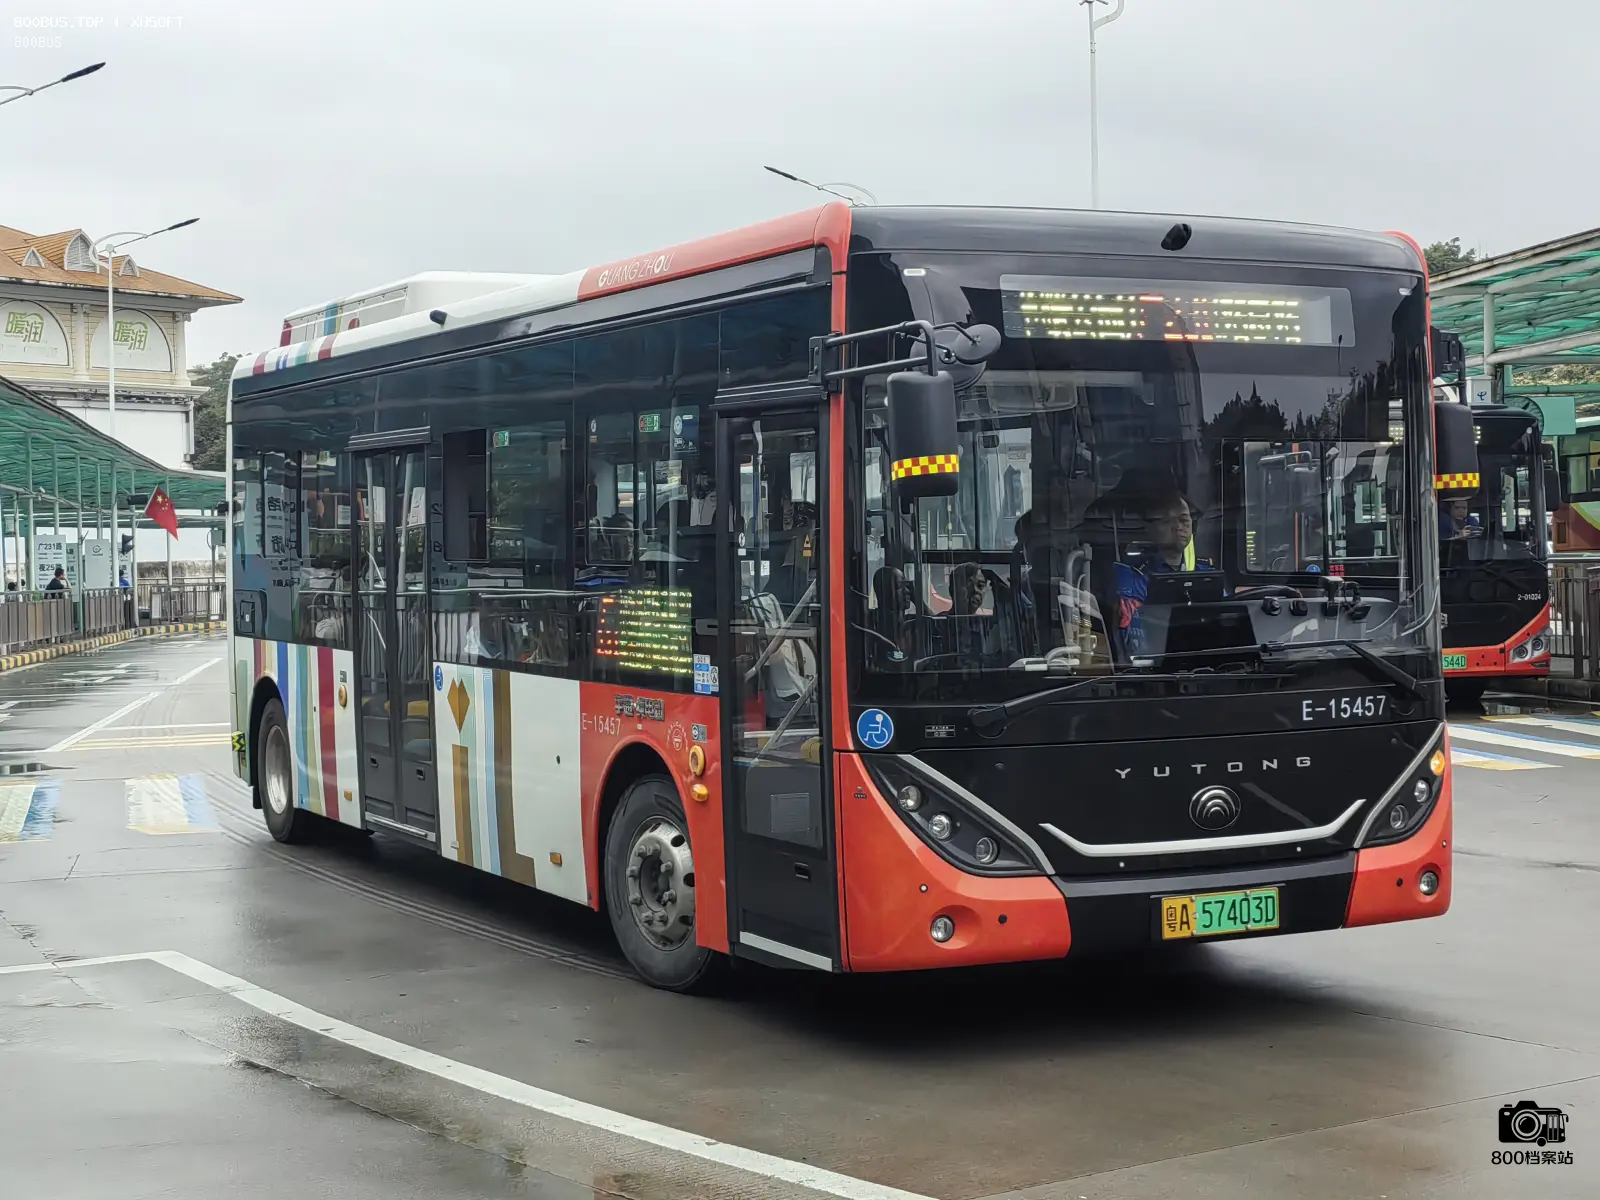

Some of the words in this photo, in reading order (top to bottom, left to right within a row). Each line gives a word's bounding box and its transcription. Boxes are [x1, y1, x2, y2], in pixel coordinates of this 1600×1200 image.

[598, 253, 675, 288] GUANGZHOU
[1302, 695, 1387, 721] E-15457
[582, 713, 621, 736] E-15457
[1115, 756, 1312, 779] YUTONG
